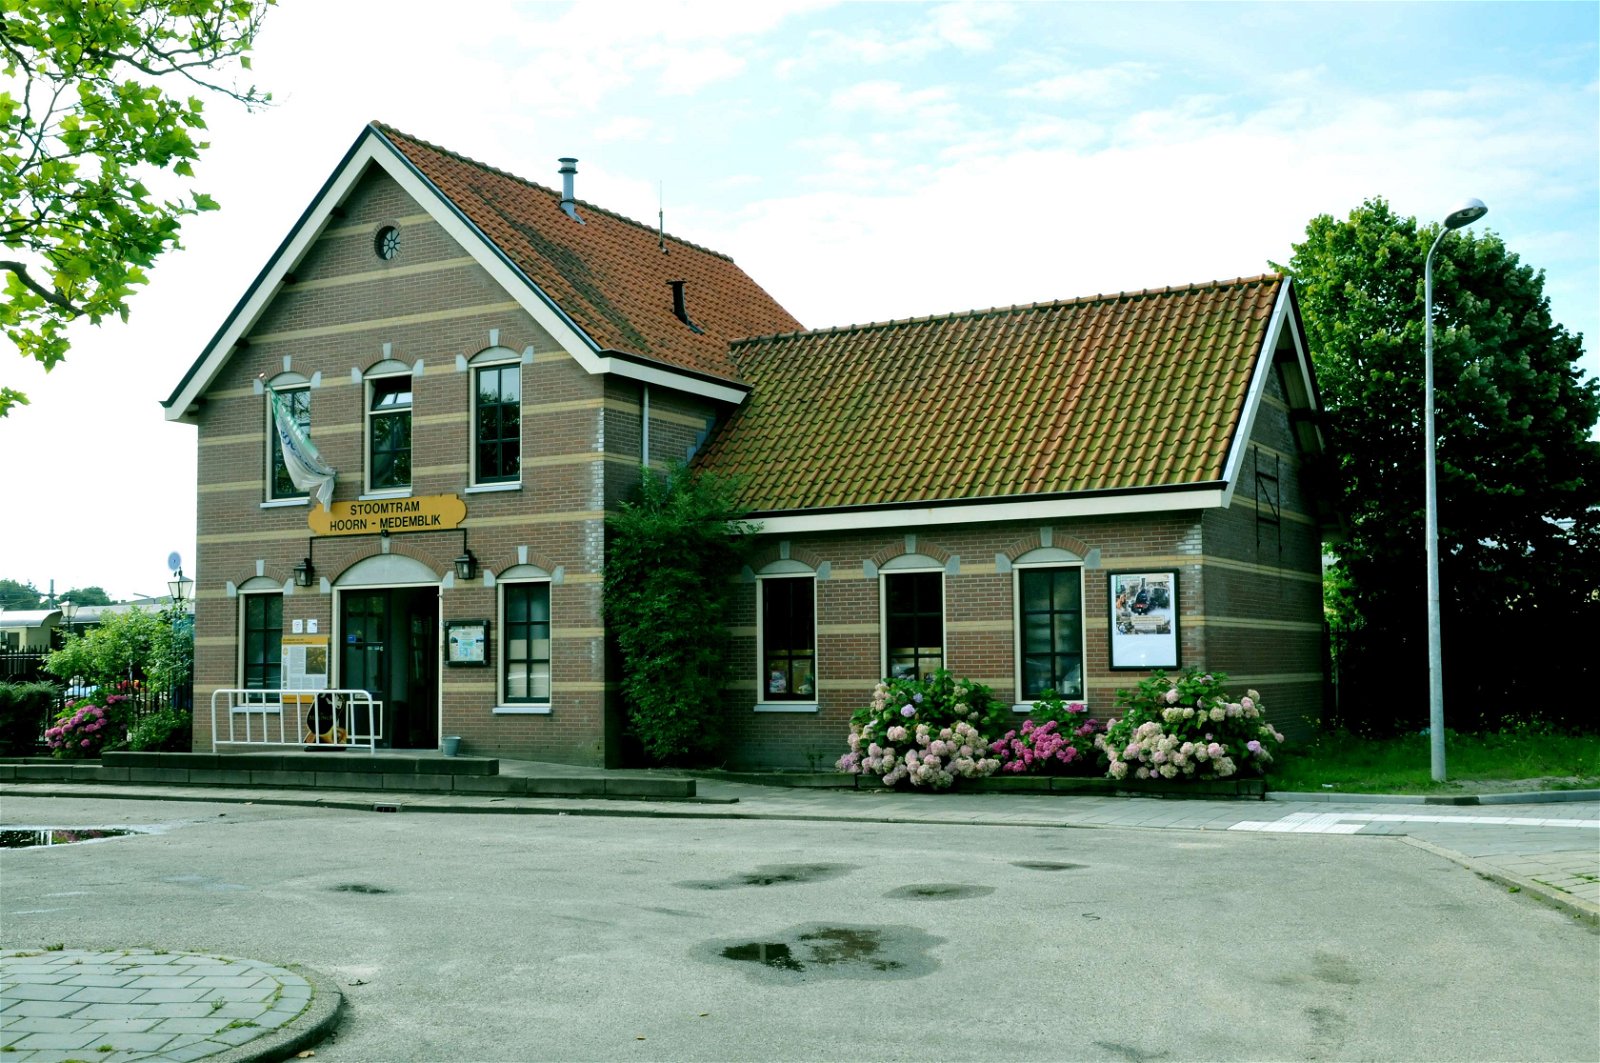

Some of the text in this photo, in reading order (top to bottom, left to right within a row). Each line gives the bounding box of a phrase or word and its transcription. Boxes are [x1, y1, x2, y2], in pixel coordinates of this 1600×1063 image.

[350, 501, 420, 516] STOOMTRAM
[330, 519, 367, 531] HOORN
[380, 514, 441, 529] MEDEMBLIK
